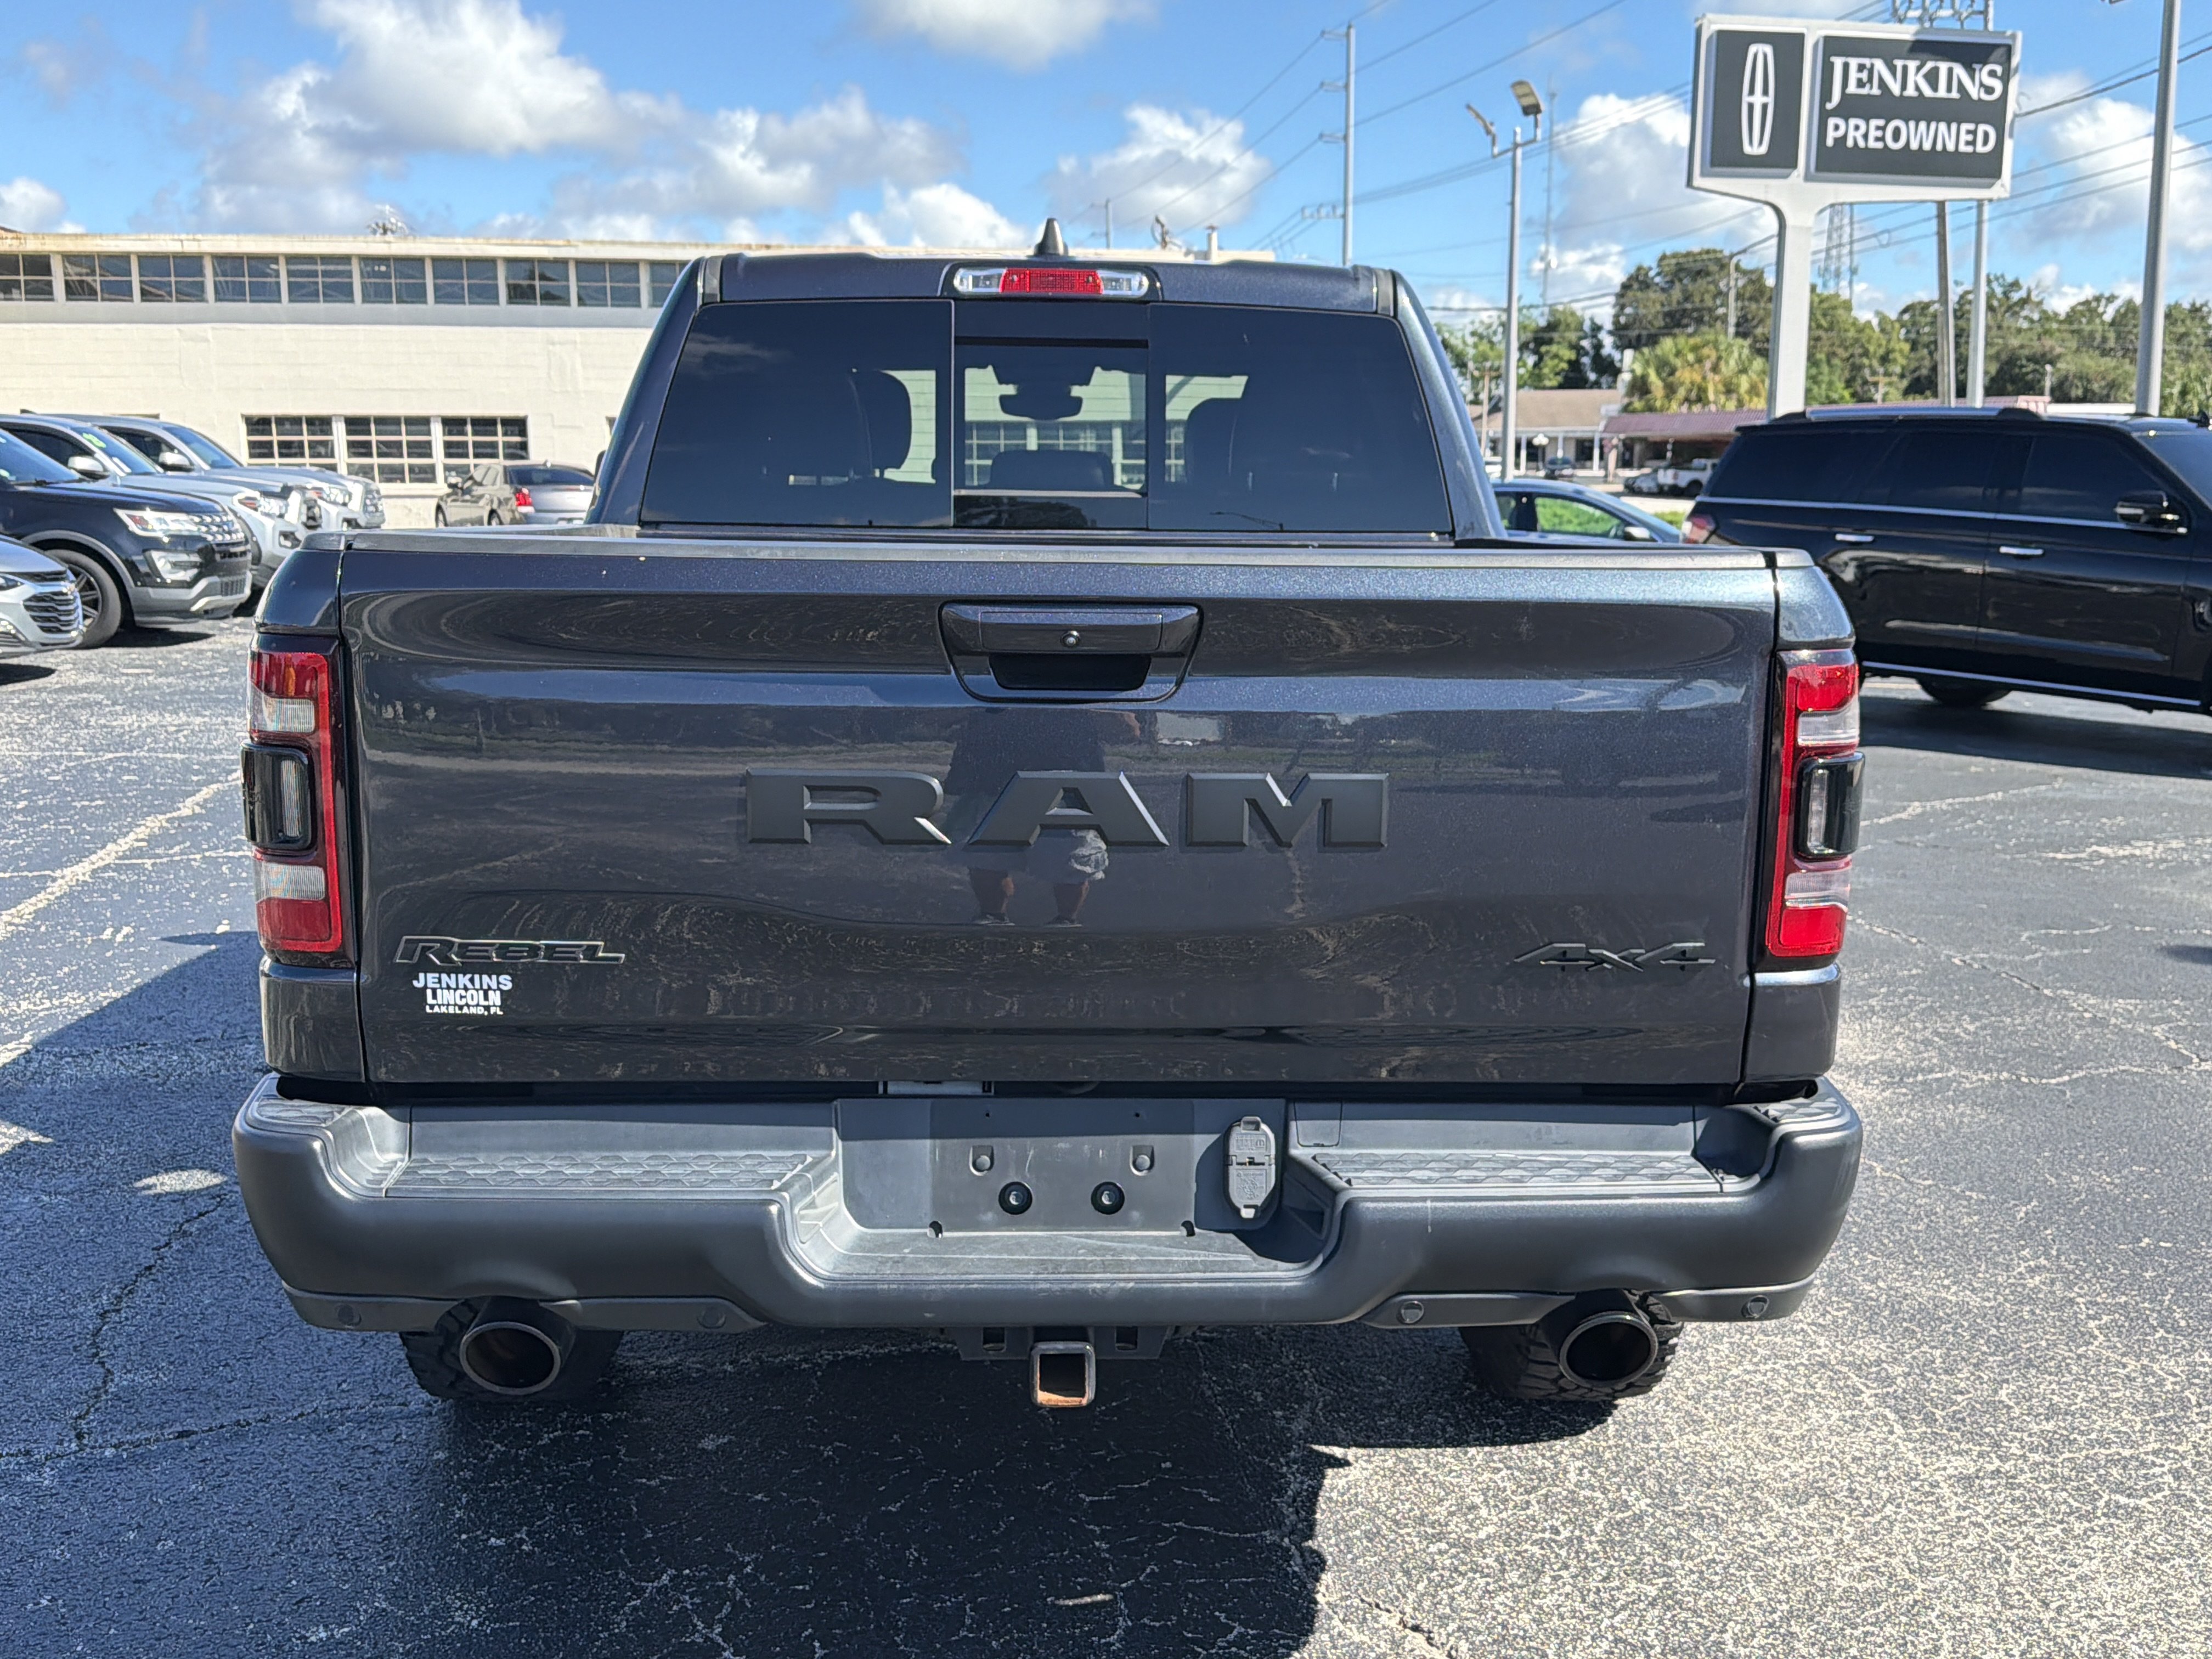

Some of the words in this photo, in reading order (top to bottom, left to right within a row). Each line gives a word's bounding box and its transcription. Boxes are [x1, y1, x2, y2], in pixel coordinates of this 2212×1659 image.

[1825, 56, 2004, 110] JENKINS
[1826, 117, 1996, 153] PREOWNED
[746, 769, 1390, 848] RAM
[413, 972, 512, 991] JENKINS
[426, 989, 501, 1006] LINCOLN
[426, 1006, 488, 1015] LAKELAND,
[490, 1006, 504, 1015] FL
